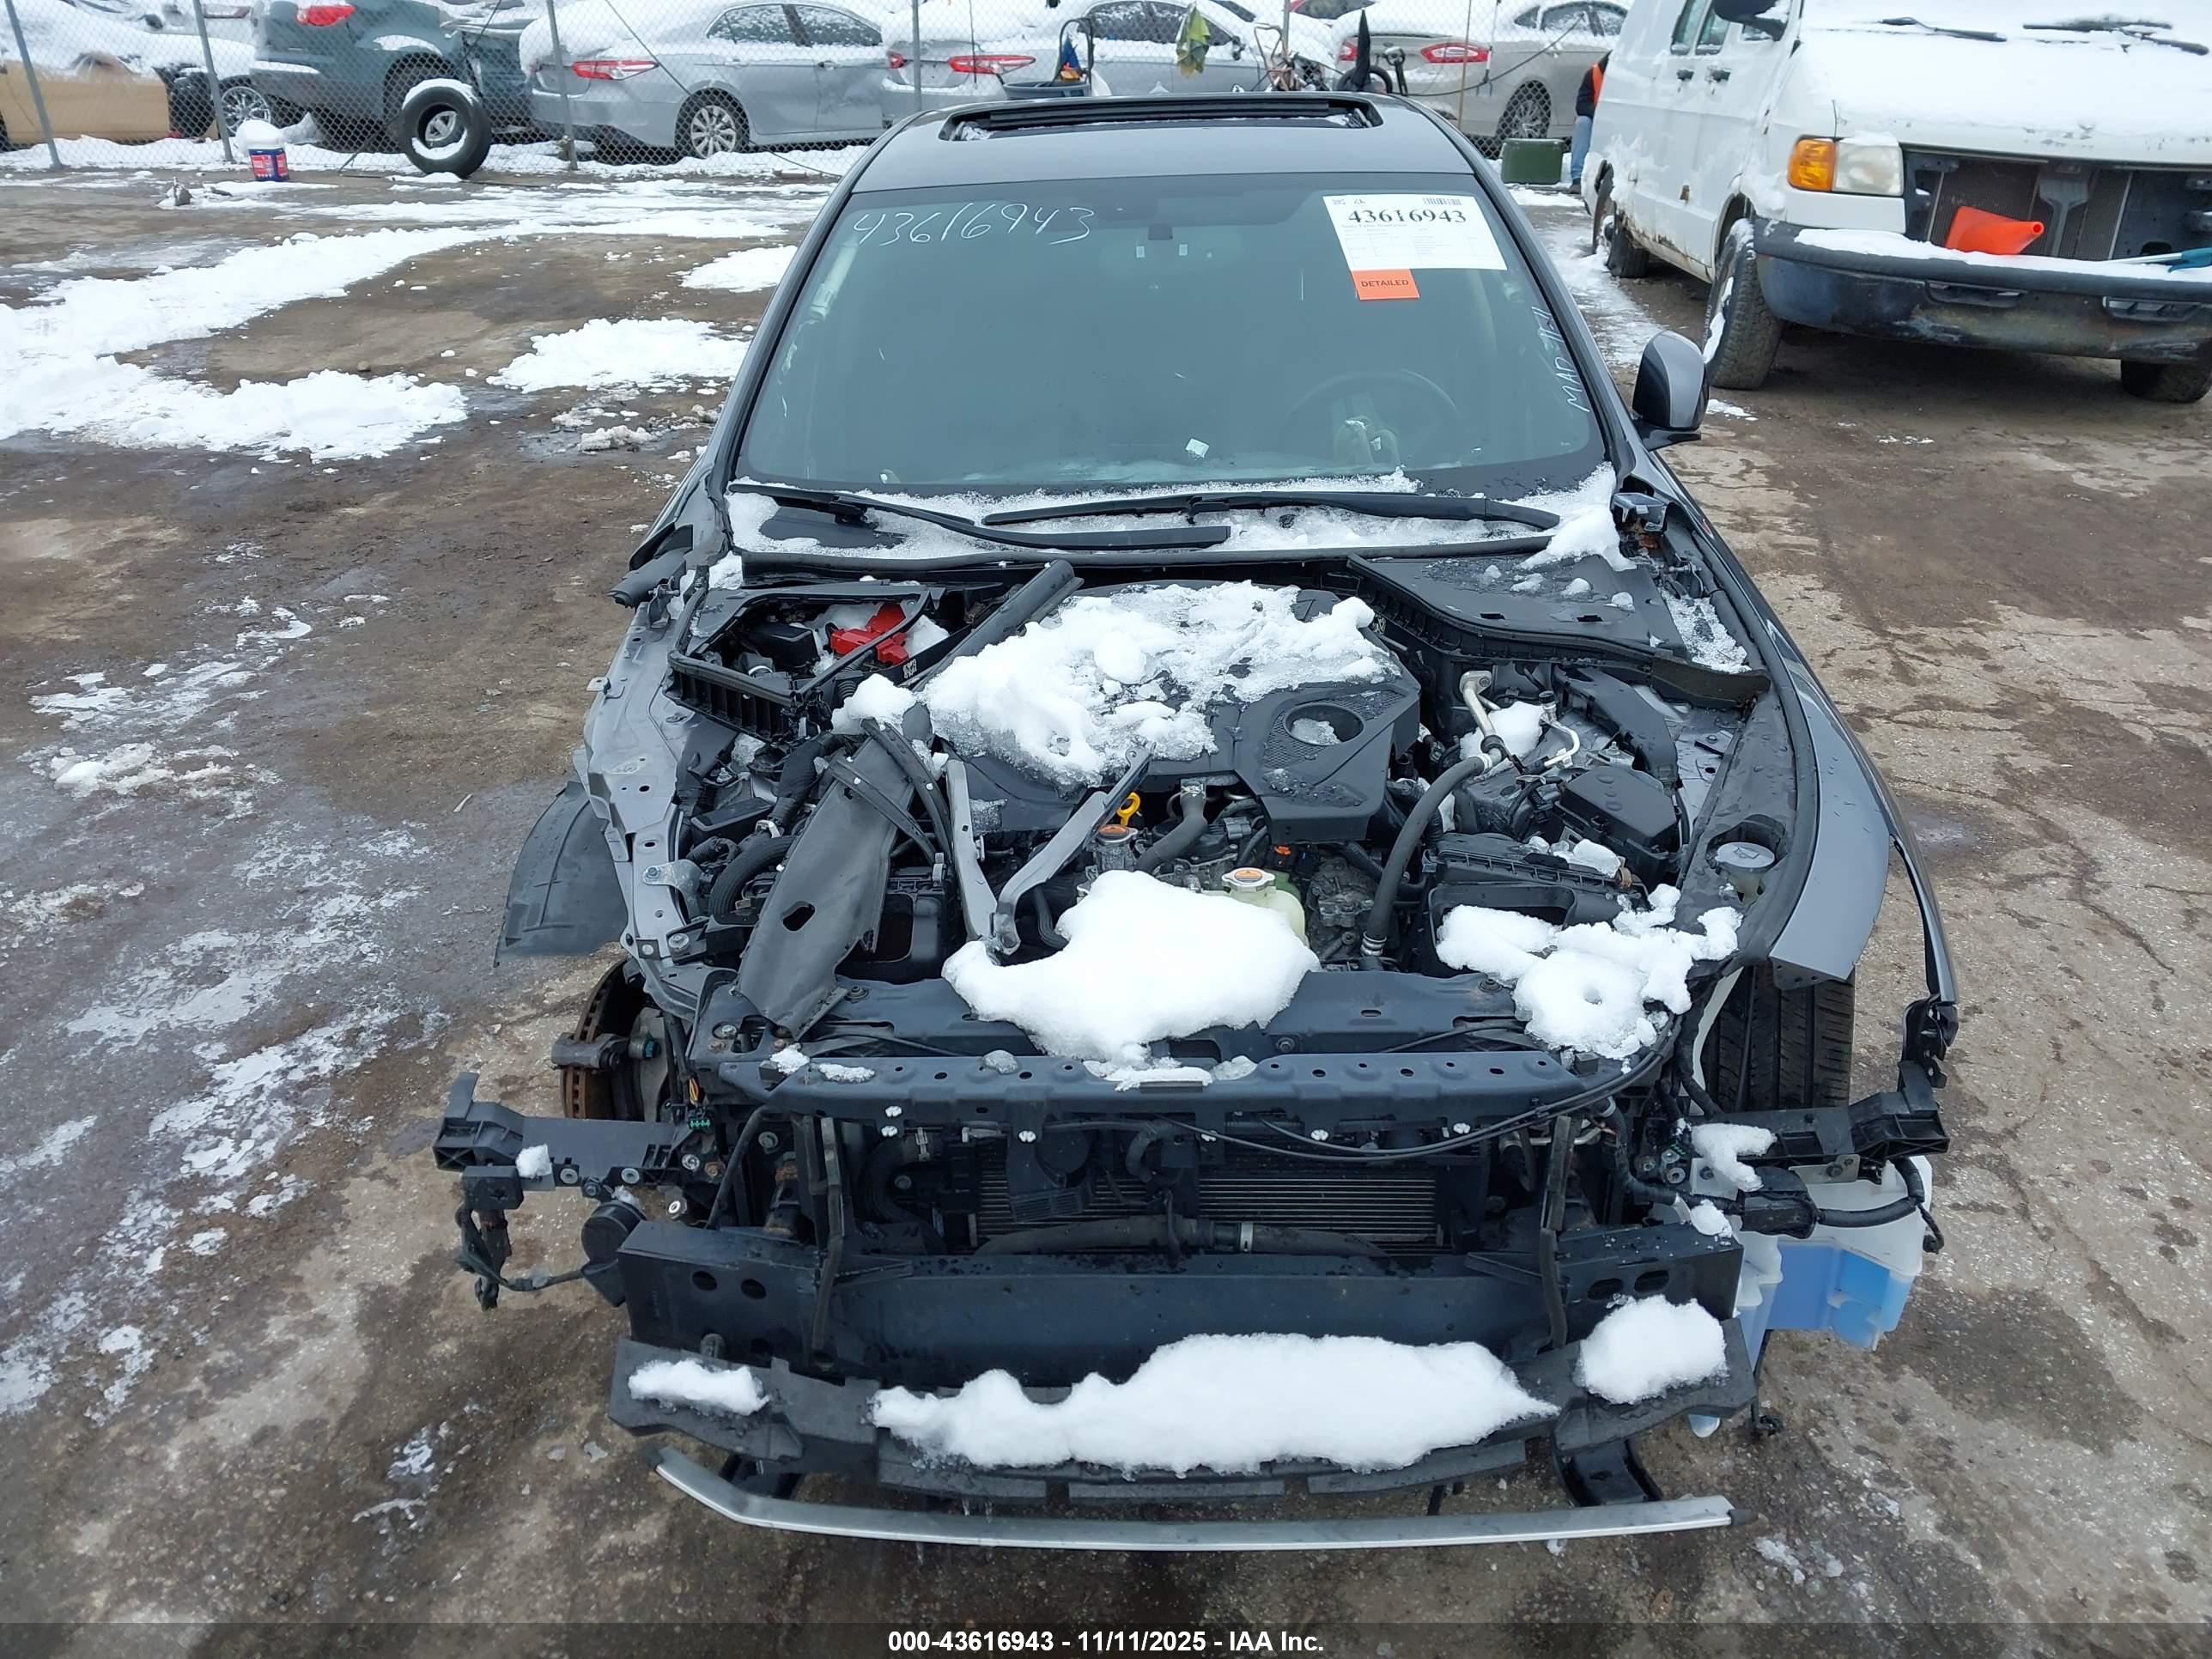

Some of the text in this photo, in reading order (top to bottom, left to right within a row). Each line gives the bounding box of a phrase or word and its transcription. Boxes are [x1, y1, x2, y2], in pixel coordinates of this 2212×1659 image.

[1347, 208, 1468, 224] 43616943
[854, 203, 1095, 246] 43616943
[1360, 278, 1410, 289] DETAILED
